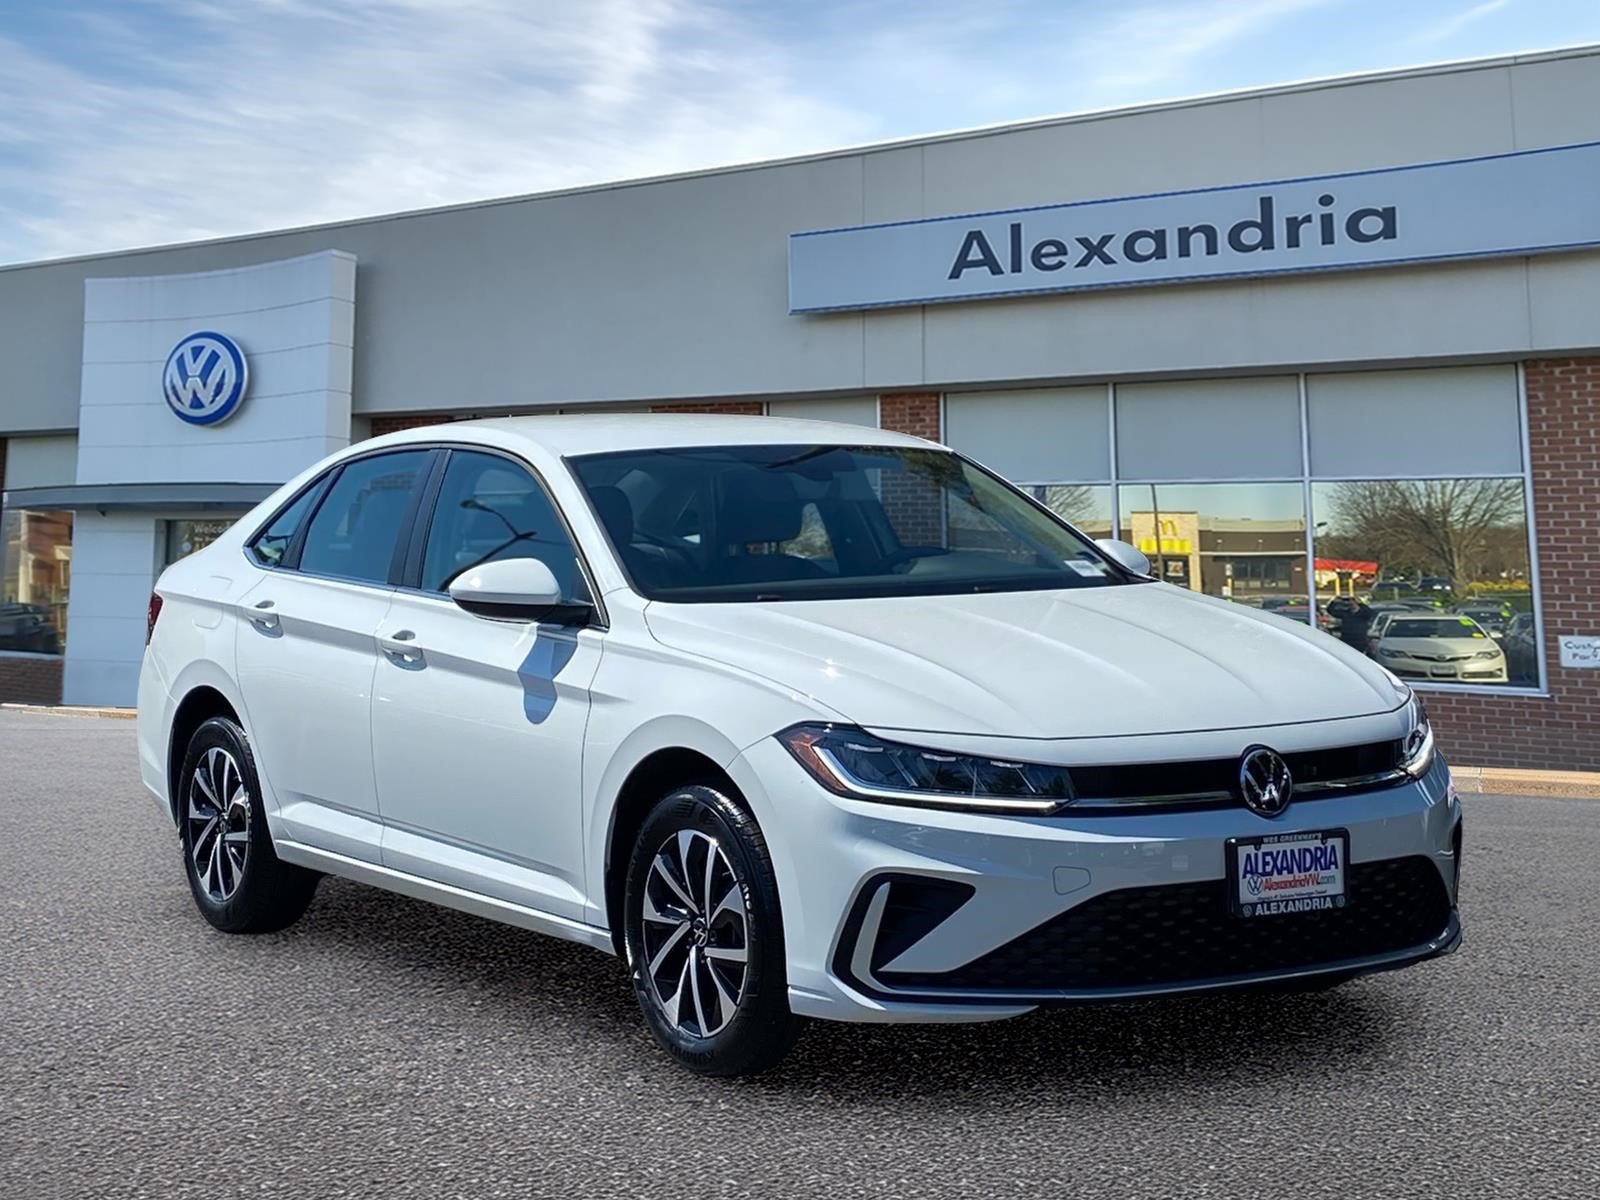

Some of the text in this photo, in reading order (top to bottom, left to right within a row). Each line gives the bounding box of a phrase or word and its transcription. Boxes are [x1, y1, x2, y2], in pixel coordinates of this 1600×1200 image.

[947, 194, 1397, 280] Alexandria
[1242, 844, 1338, 879] ALEXANDRIA
[1255, 897, 1333, 916] ALEXANDRIA
